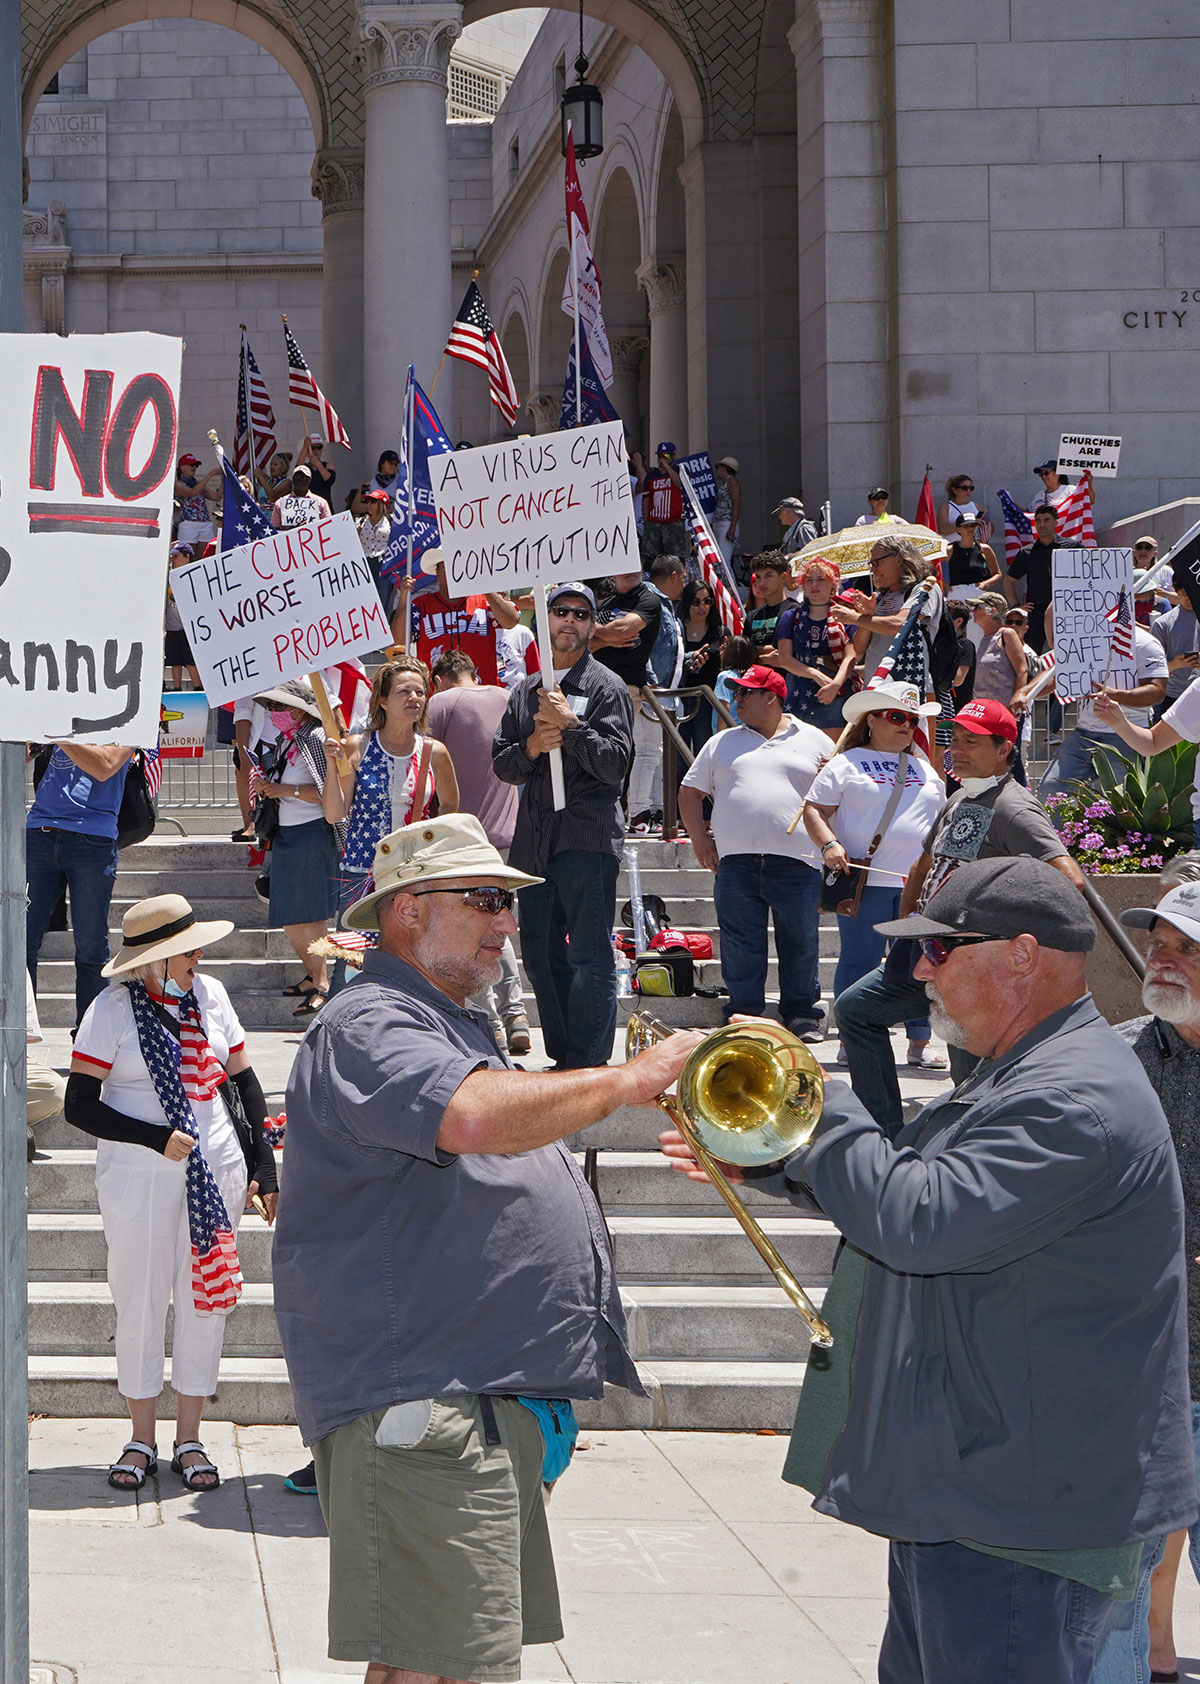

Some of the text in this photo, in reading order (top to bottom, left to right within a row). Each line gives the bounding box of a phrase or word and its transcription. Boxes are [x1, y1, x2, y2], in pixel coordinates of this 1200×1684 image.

[1123, 311, 1188, 329] CITY
[28, 364, 178, 503] NO
[1061, 436, 1121, 447] CHURCHES
[439, 433, 623, 492] A VIRUS CAN
[1078, 447, 1102, 456] ARE
[1058, 458, 1117, 469] ESSENTIAL
[652, 477, 672, 490] USA
[285, 498, 316, 511] BACK
[294, 509, 306, 517] TO
[438, 496, 490, 535] NOT
[497, 483, 581, 525] CANCEL
[590, 472, 631, 507] THE
[286, 515, 316, 525] WORK
[451, 516, 631, 583] CONSTITUTION
[1054, 549, 1132, 580] LIBERTY
[179, 553, 242, 603] THE
[190, 556, 372, 645] IS WORSE THAN
[1053, 590, 1134, 613] FREEDOM
[422, 608, 490, 641] USA
[1055, 613, 1115, 635] BEFORE
[212, 602, 388, 687] THE PROBLEM
[161, 736, 205, 746] ALIFORNIA
